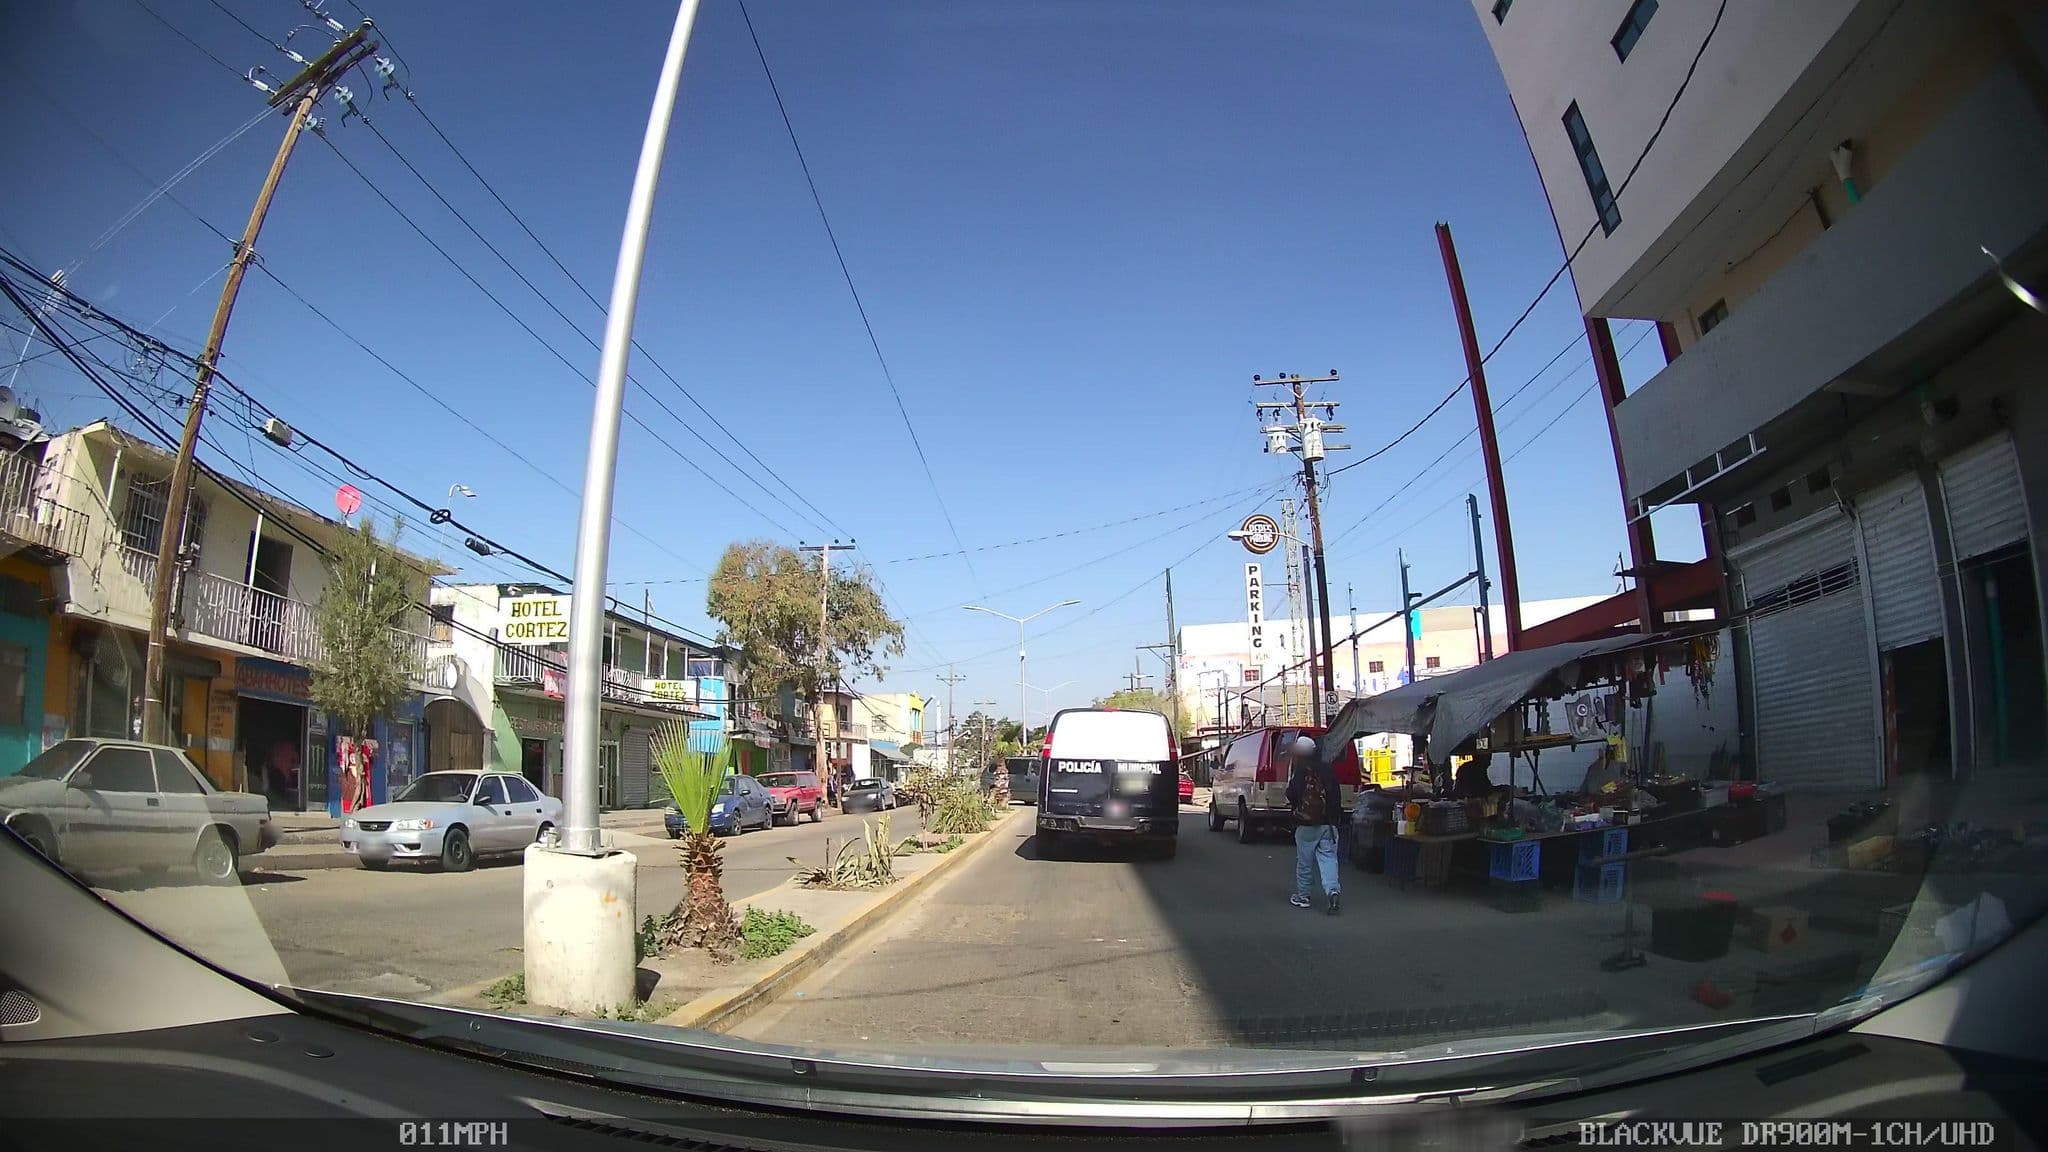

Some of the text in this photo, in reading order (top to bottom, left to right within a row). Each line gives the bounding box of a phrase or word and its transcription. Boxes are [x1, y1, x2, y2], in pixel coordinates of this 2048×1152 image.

[511, 600, 562, 618] HOTEL
[1248, 566, 1262, 648] PARKING
[506, 621, 568, 638] CORTEZ
[655, 681, 684, 690] HOTEL
[1058, 760, 1162, 774] POLICÍA MUNICIPAL
